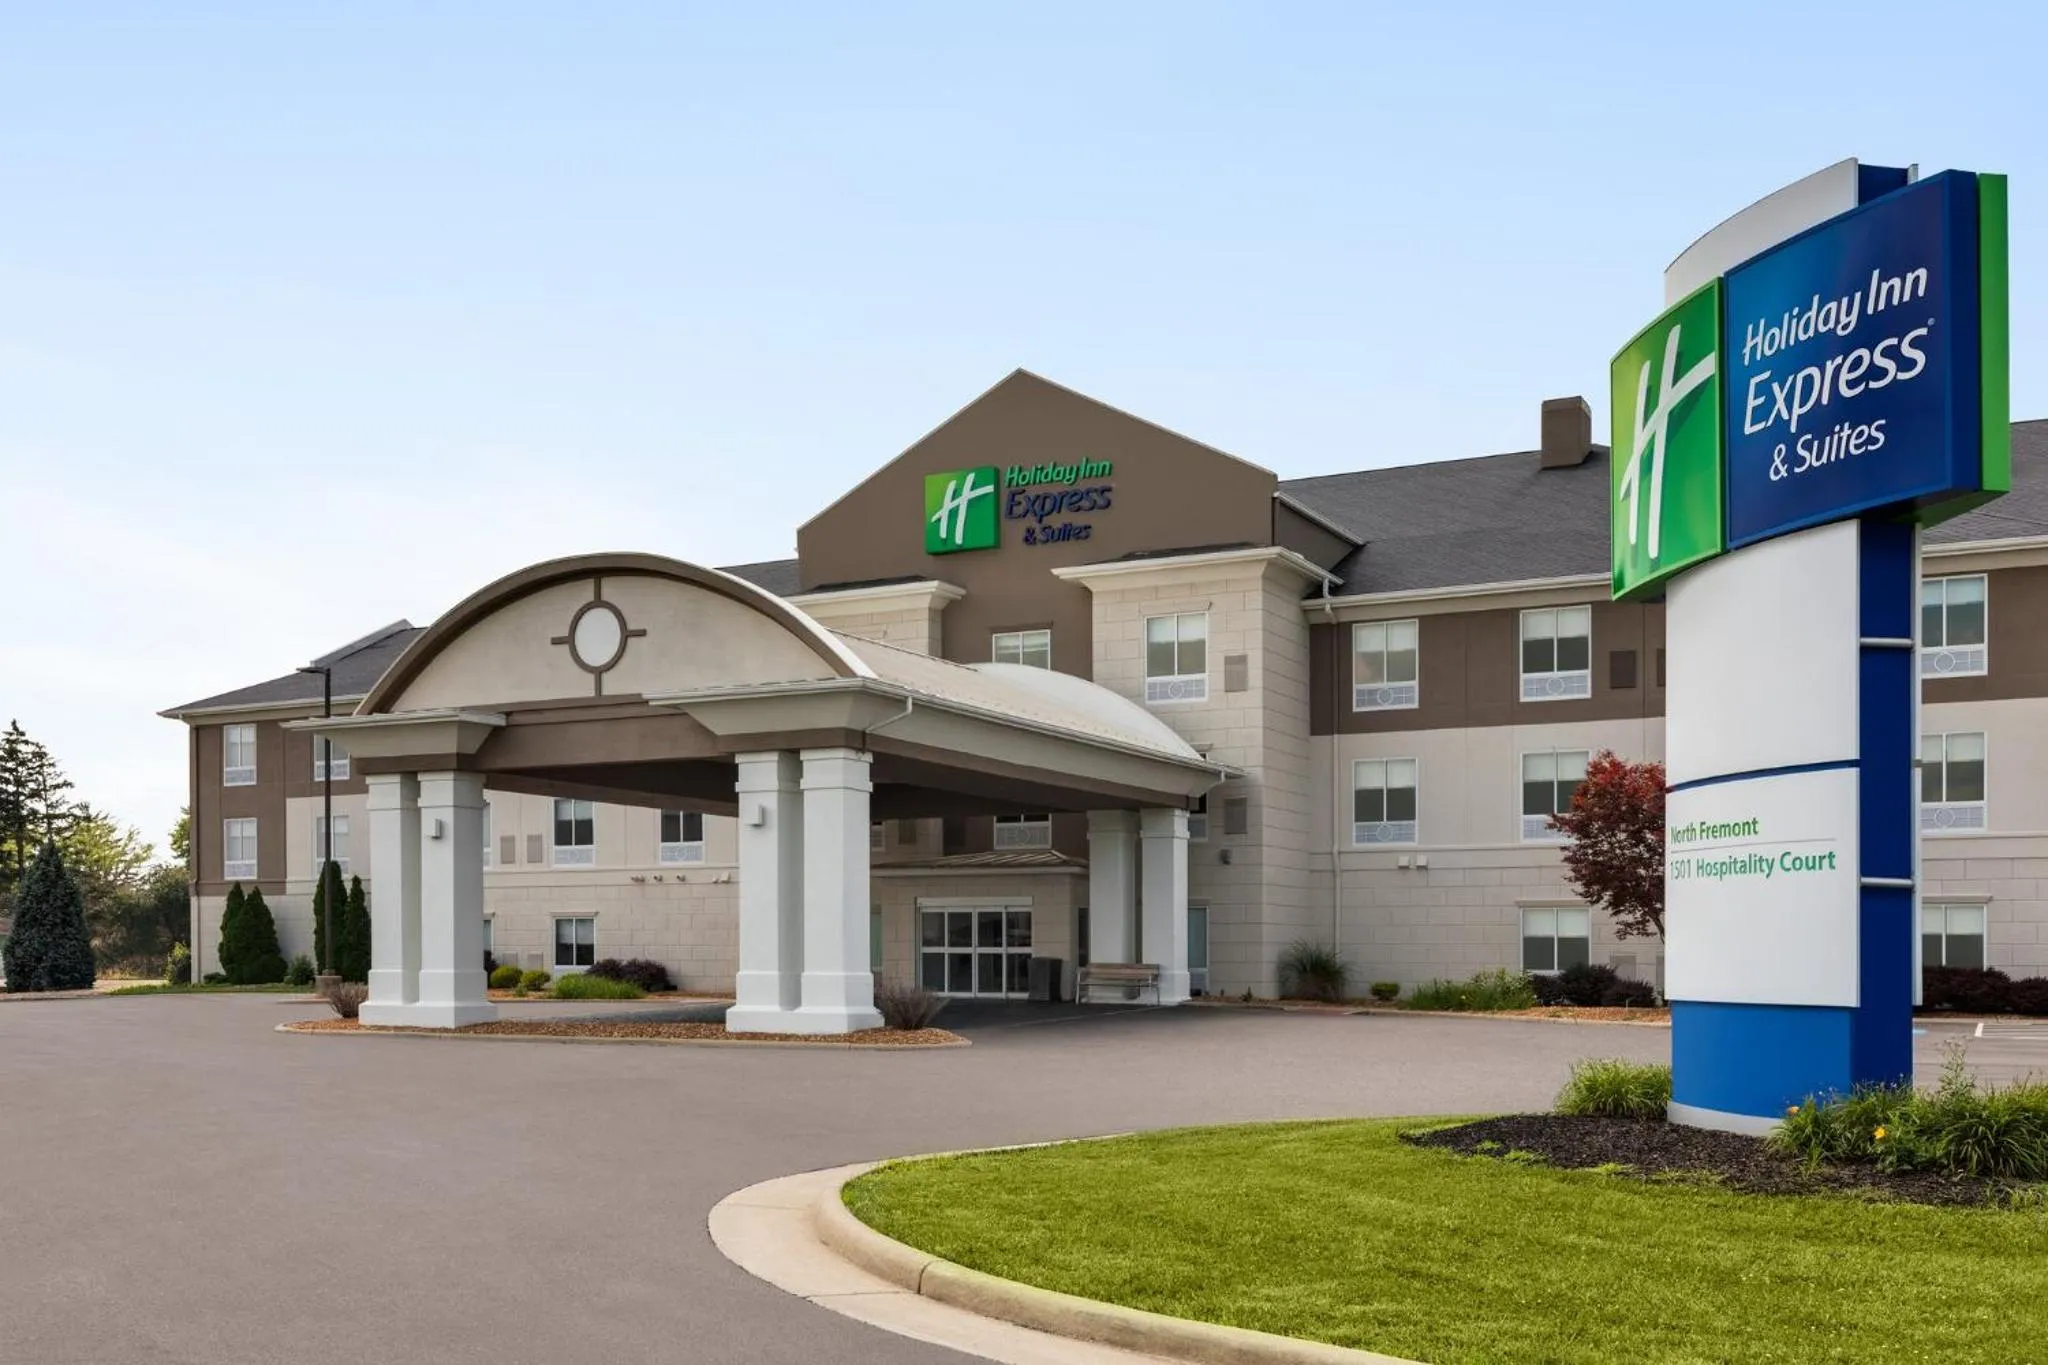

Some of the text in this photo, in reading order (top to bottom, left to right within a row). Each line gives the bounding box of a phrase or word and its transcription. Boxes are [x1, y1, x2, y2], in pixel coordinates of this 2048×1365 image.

[1742, 267, 1928, 366] Holiday Inn
[1743, 328, 1928, 436] Express
[1768, 420, 1887, 481] & Suites
[1005, 456, 1112, 487] Holiday Inn
[1005, 485, 1112, 524] Express
[1023, 522, 1092, 545] & Suites
[1670, 817, 1759, 845] North Fremont
[1670, 851, 1836, 881] 1501 Hospitality Court
